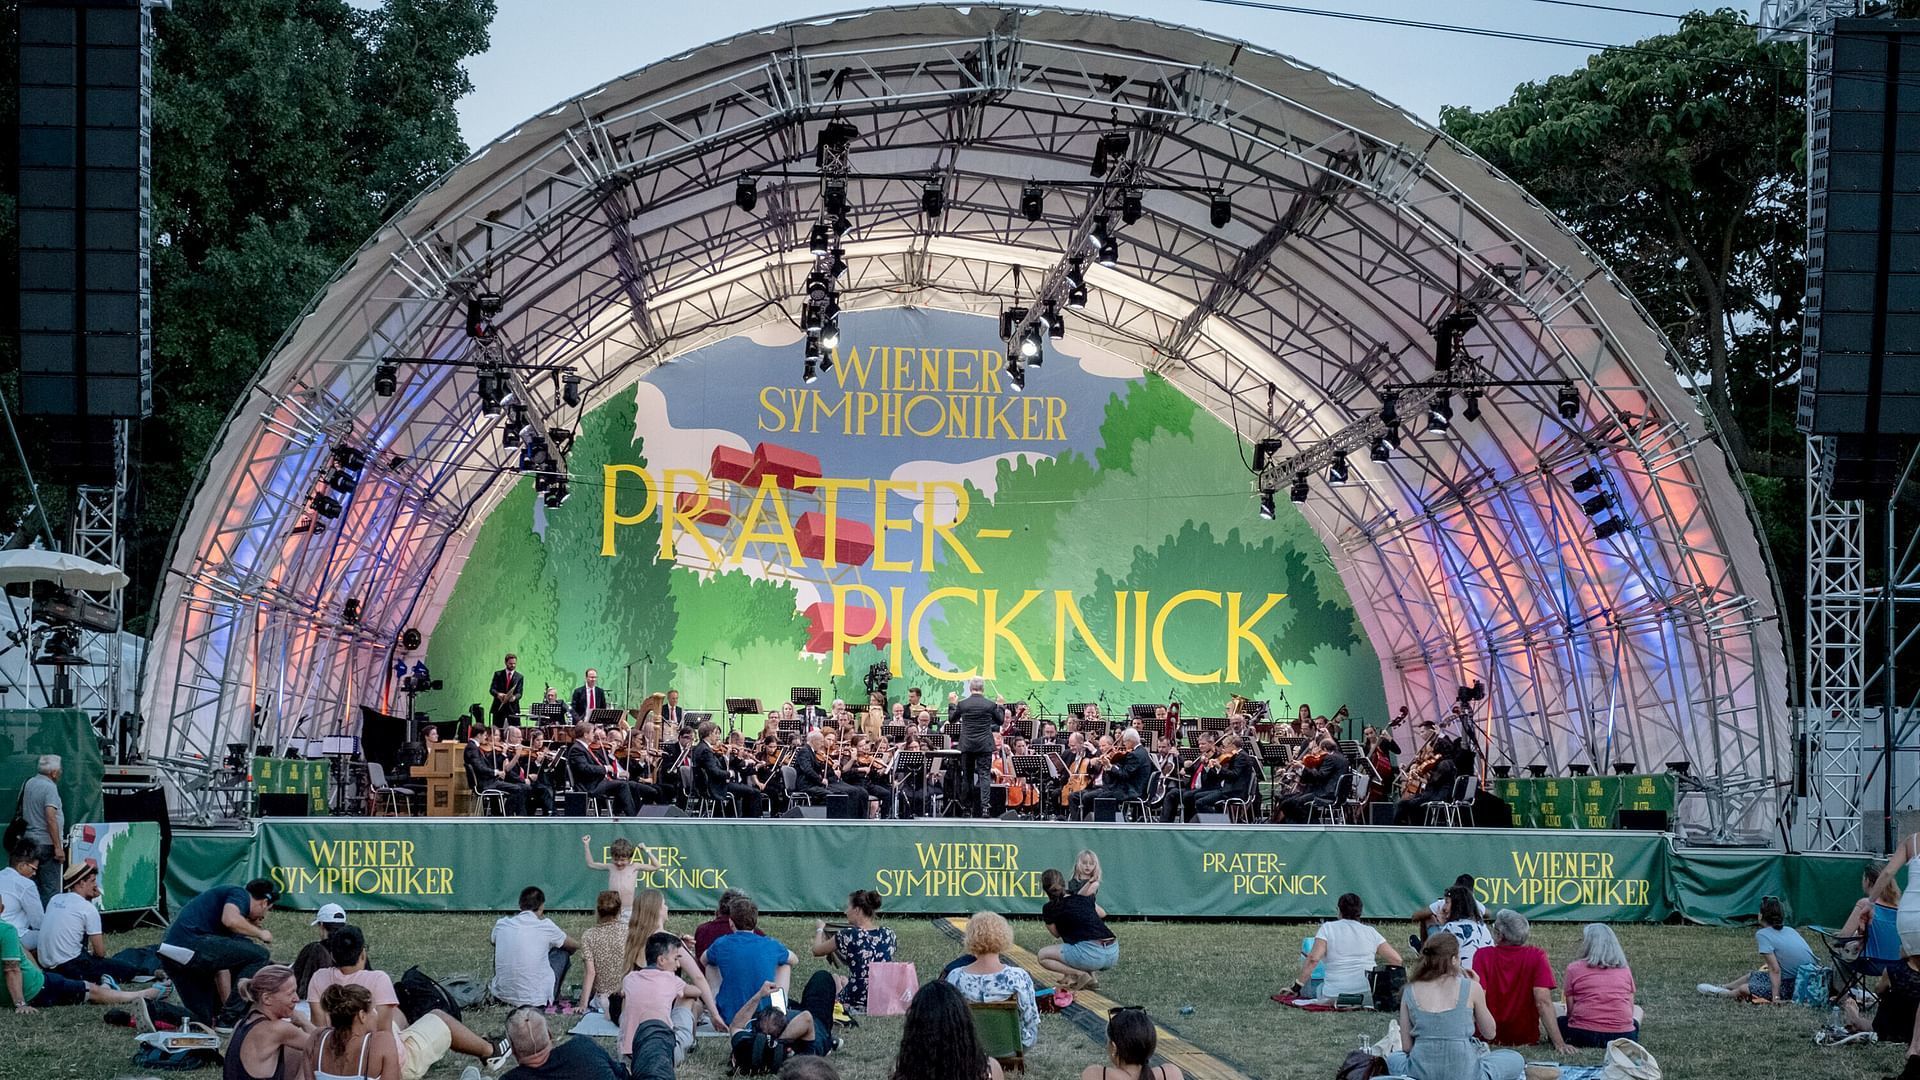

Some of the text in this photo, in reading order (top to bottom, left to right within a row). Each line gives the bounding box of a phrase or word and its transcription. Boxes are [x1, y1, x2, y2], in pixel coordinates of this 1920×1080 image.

[830, 345, 1003, 394] WIENER
[758, 386, 1068, 441] SYMPHONIKER
[600, 463, 1013, 574] PRATER-
[830, 583, 1292, 686] PICKNICK
[308, 840, 415, 867] WIENER
[603, 846, 687, 867] PATER-
[915, 842, 1019, 870] WIENER
[1203, 853, 1287, 873] PRATER-
[1511, 851, 1615, 879] WIENER
[271, 866, 454, 895] SYMPHONIKER
[635, 867, 729, 889] PICKNICK
[876, 869, 1050, 898] SYMPHONIKE
[1233, 874, 1328, 895] PICKNICK
[1474, 877, 1649, 906] SYMPHONIKER
